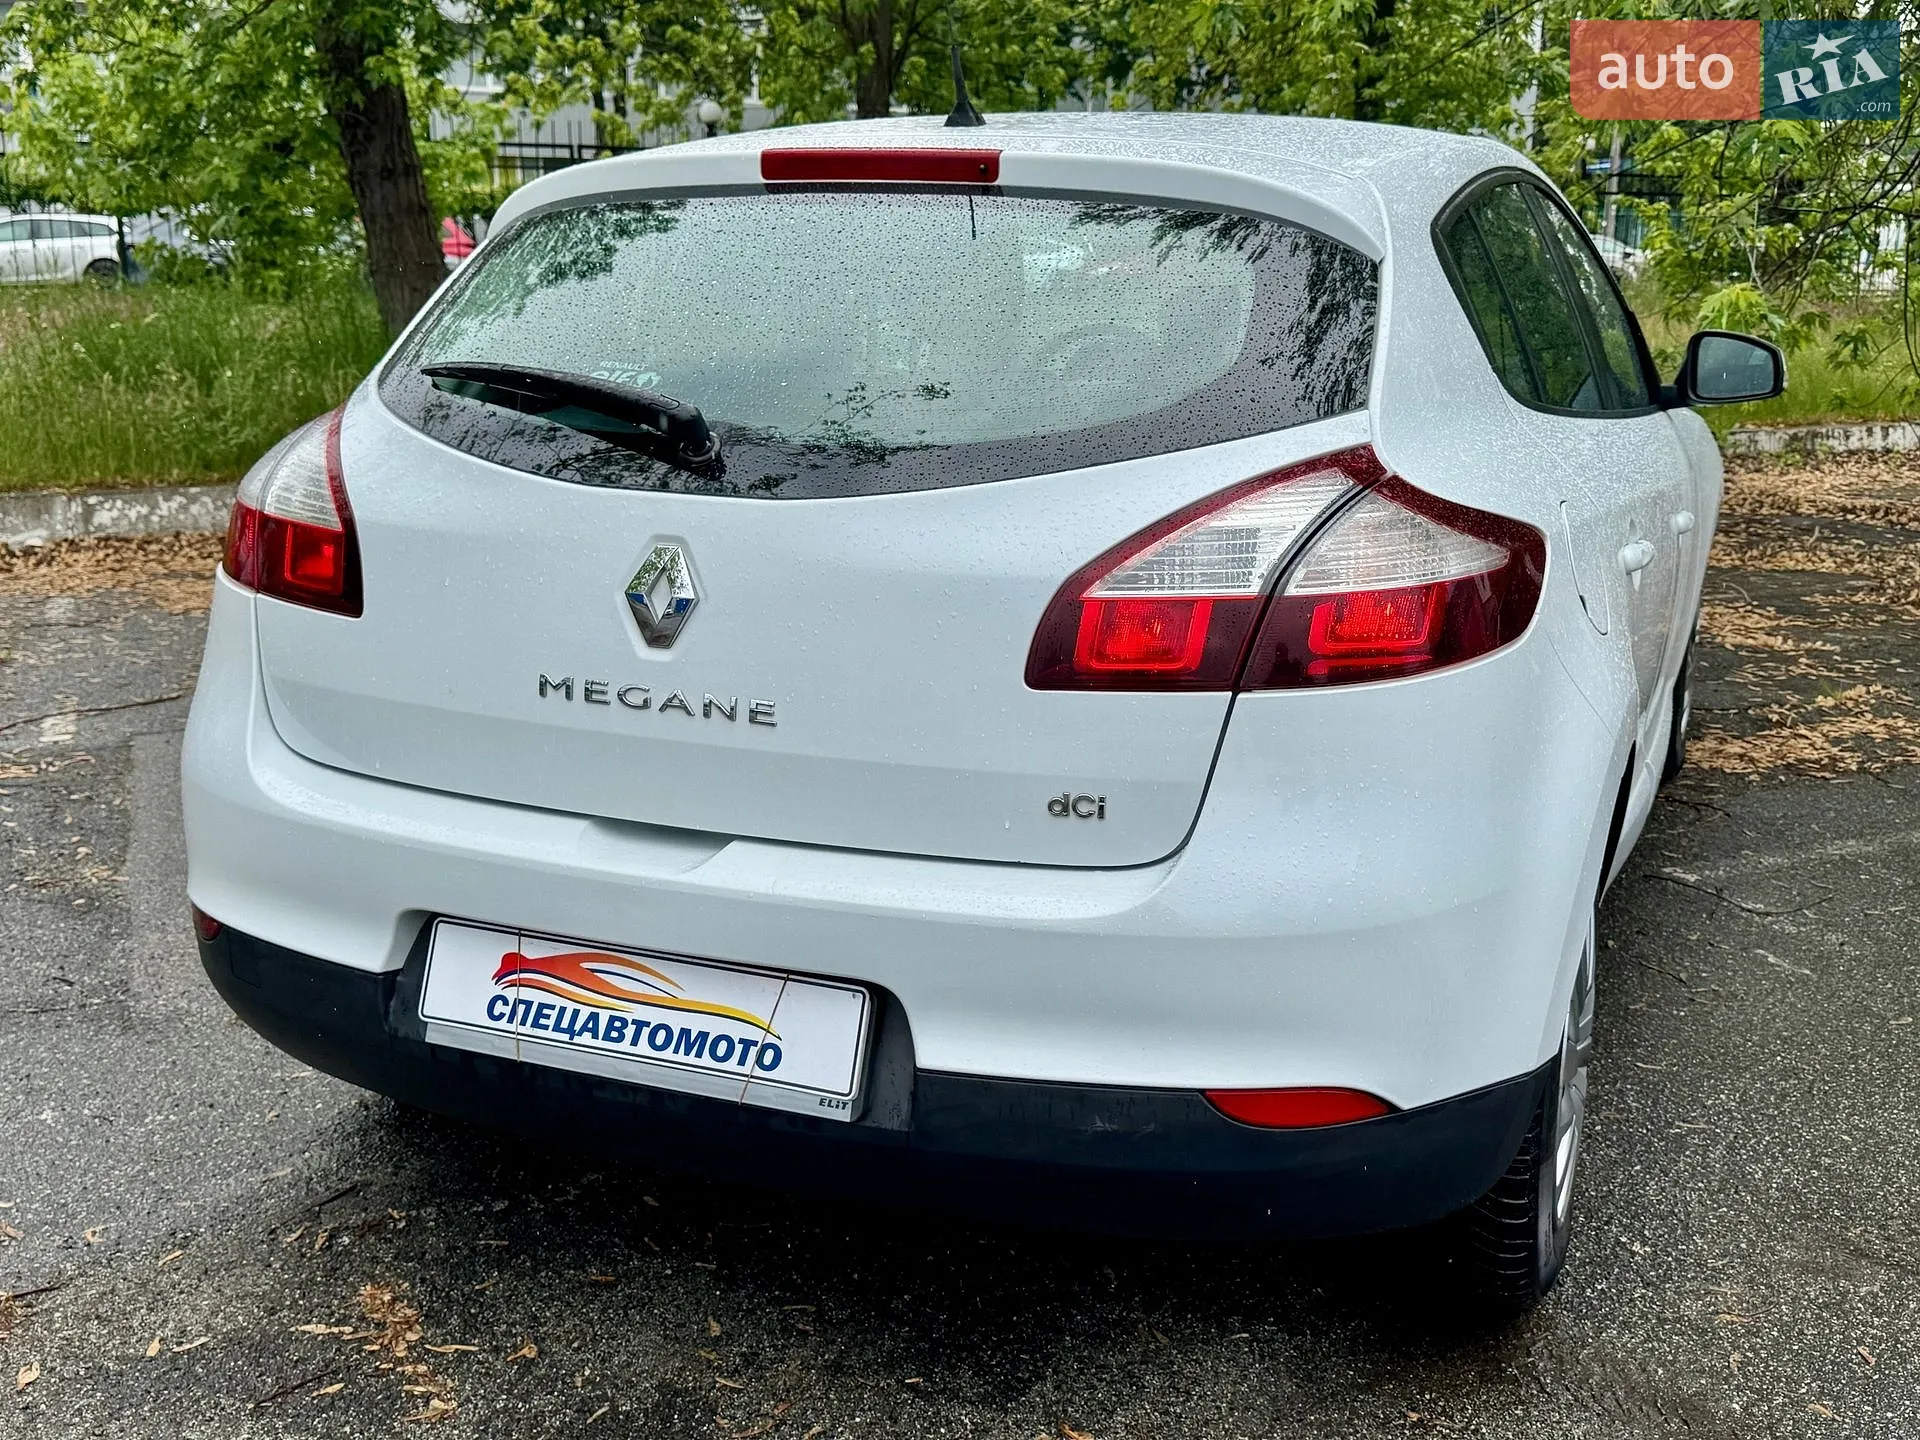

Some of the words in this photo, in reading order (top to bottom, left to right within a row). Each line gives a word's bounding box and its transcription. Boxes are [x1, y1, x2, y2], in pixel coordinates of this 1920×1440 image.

[600, 360, 649, 371] RENAULT
[538, 672, 777, 727] MEGANE
[1047, 792, 1107, 819] dCi
[486, 993, 783, 1072] СПЕЦАВТОМОТО
